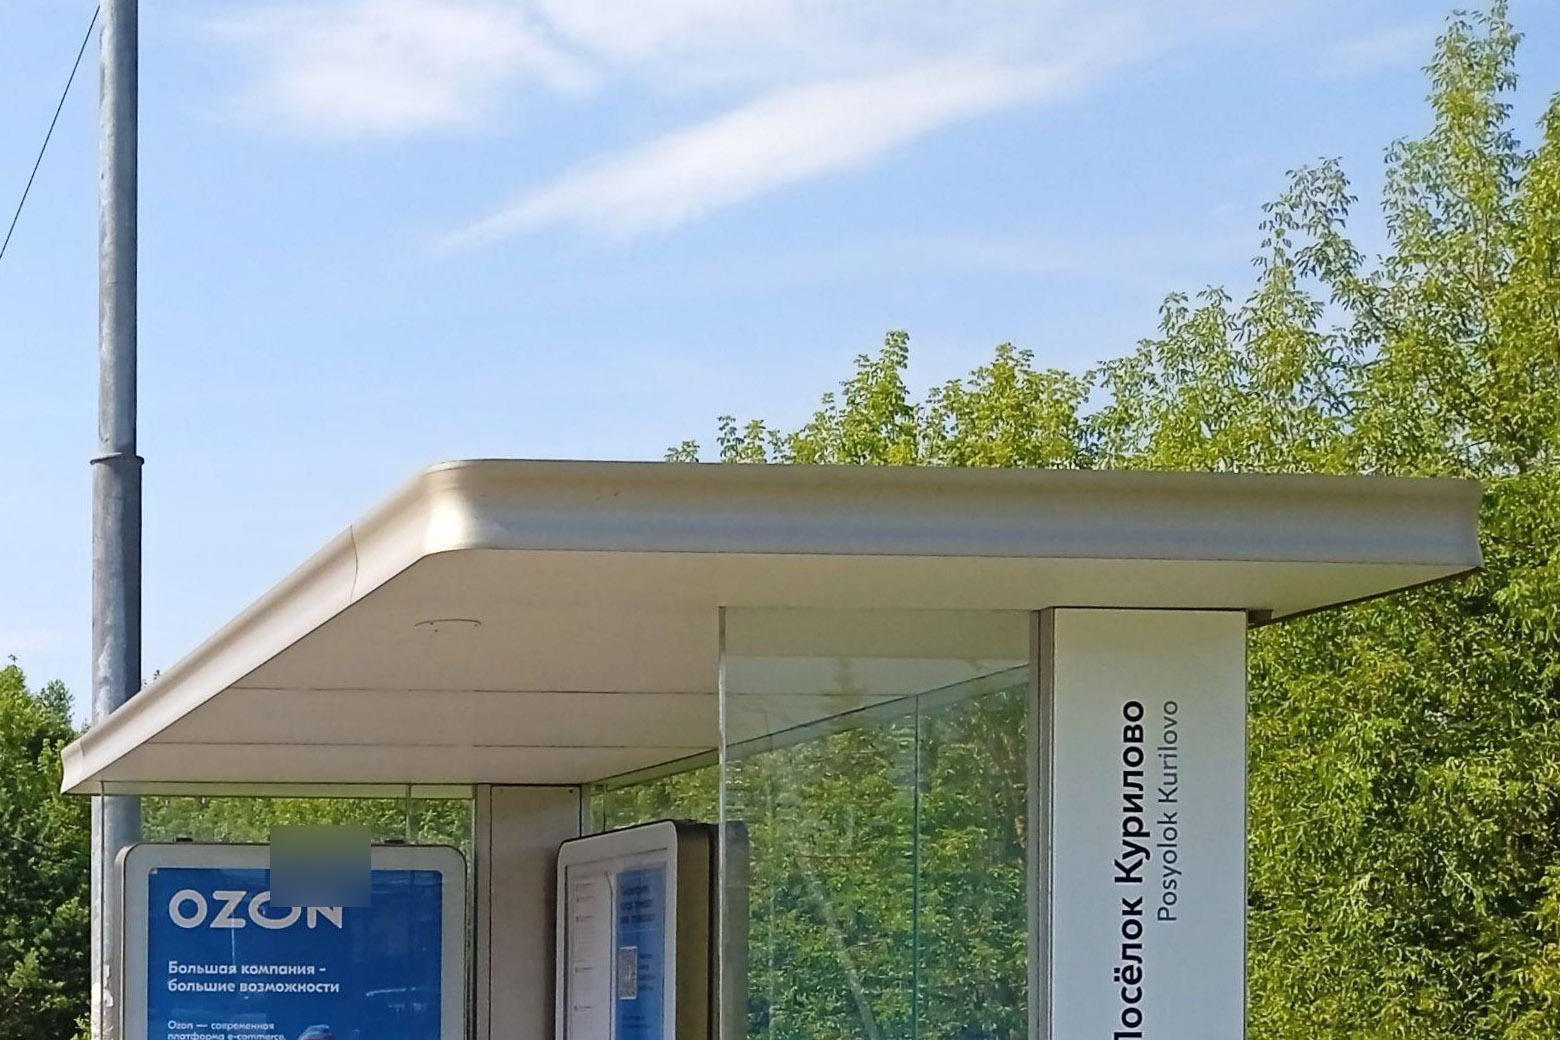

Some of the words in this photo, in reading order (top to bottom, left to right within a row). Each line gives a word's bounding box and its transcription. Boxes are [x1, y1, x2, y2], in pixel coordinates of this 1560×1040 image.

[1114, 700, 1151, 884] Курилово
[1157, 700, 1178, 803] Kurilovo
[1157, 811, 1182, 922] Posyolok
[167, 978, 236, 993] большие
[239, 982, 340, 994] возможности
[168, 960, 237, 975] Большая
[241, 963, 315, 976] компания
